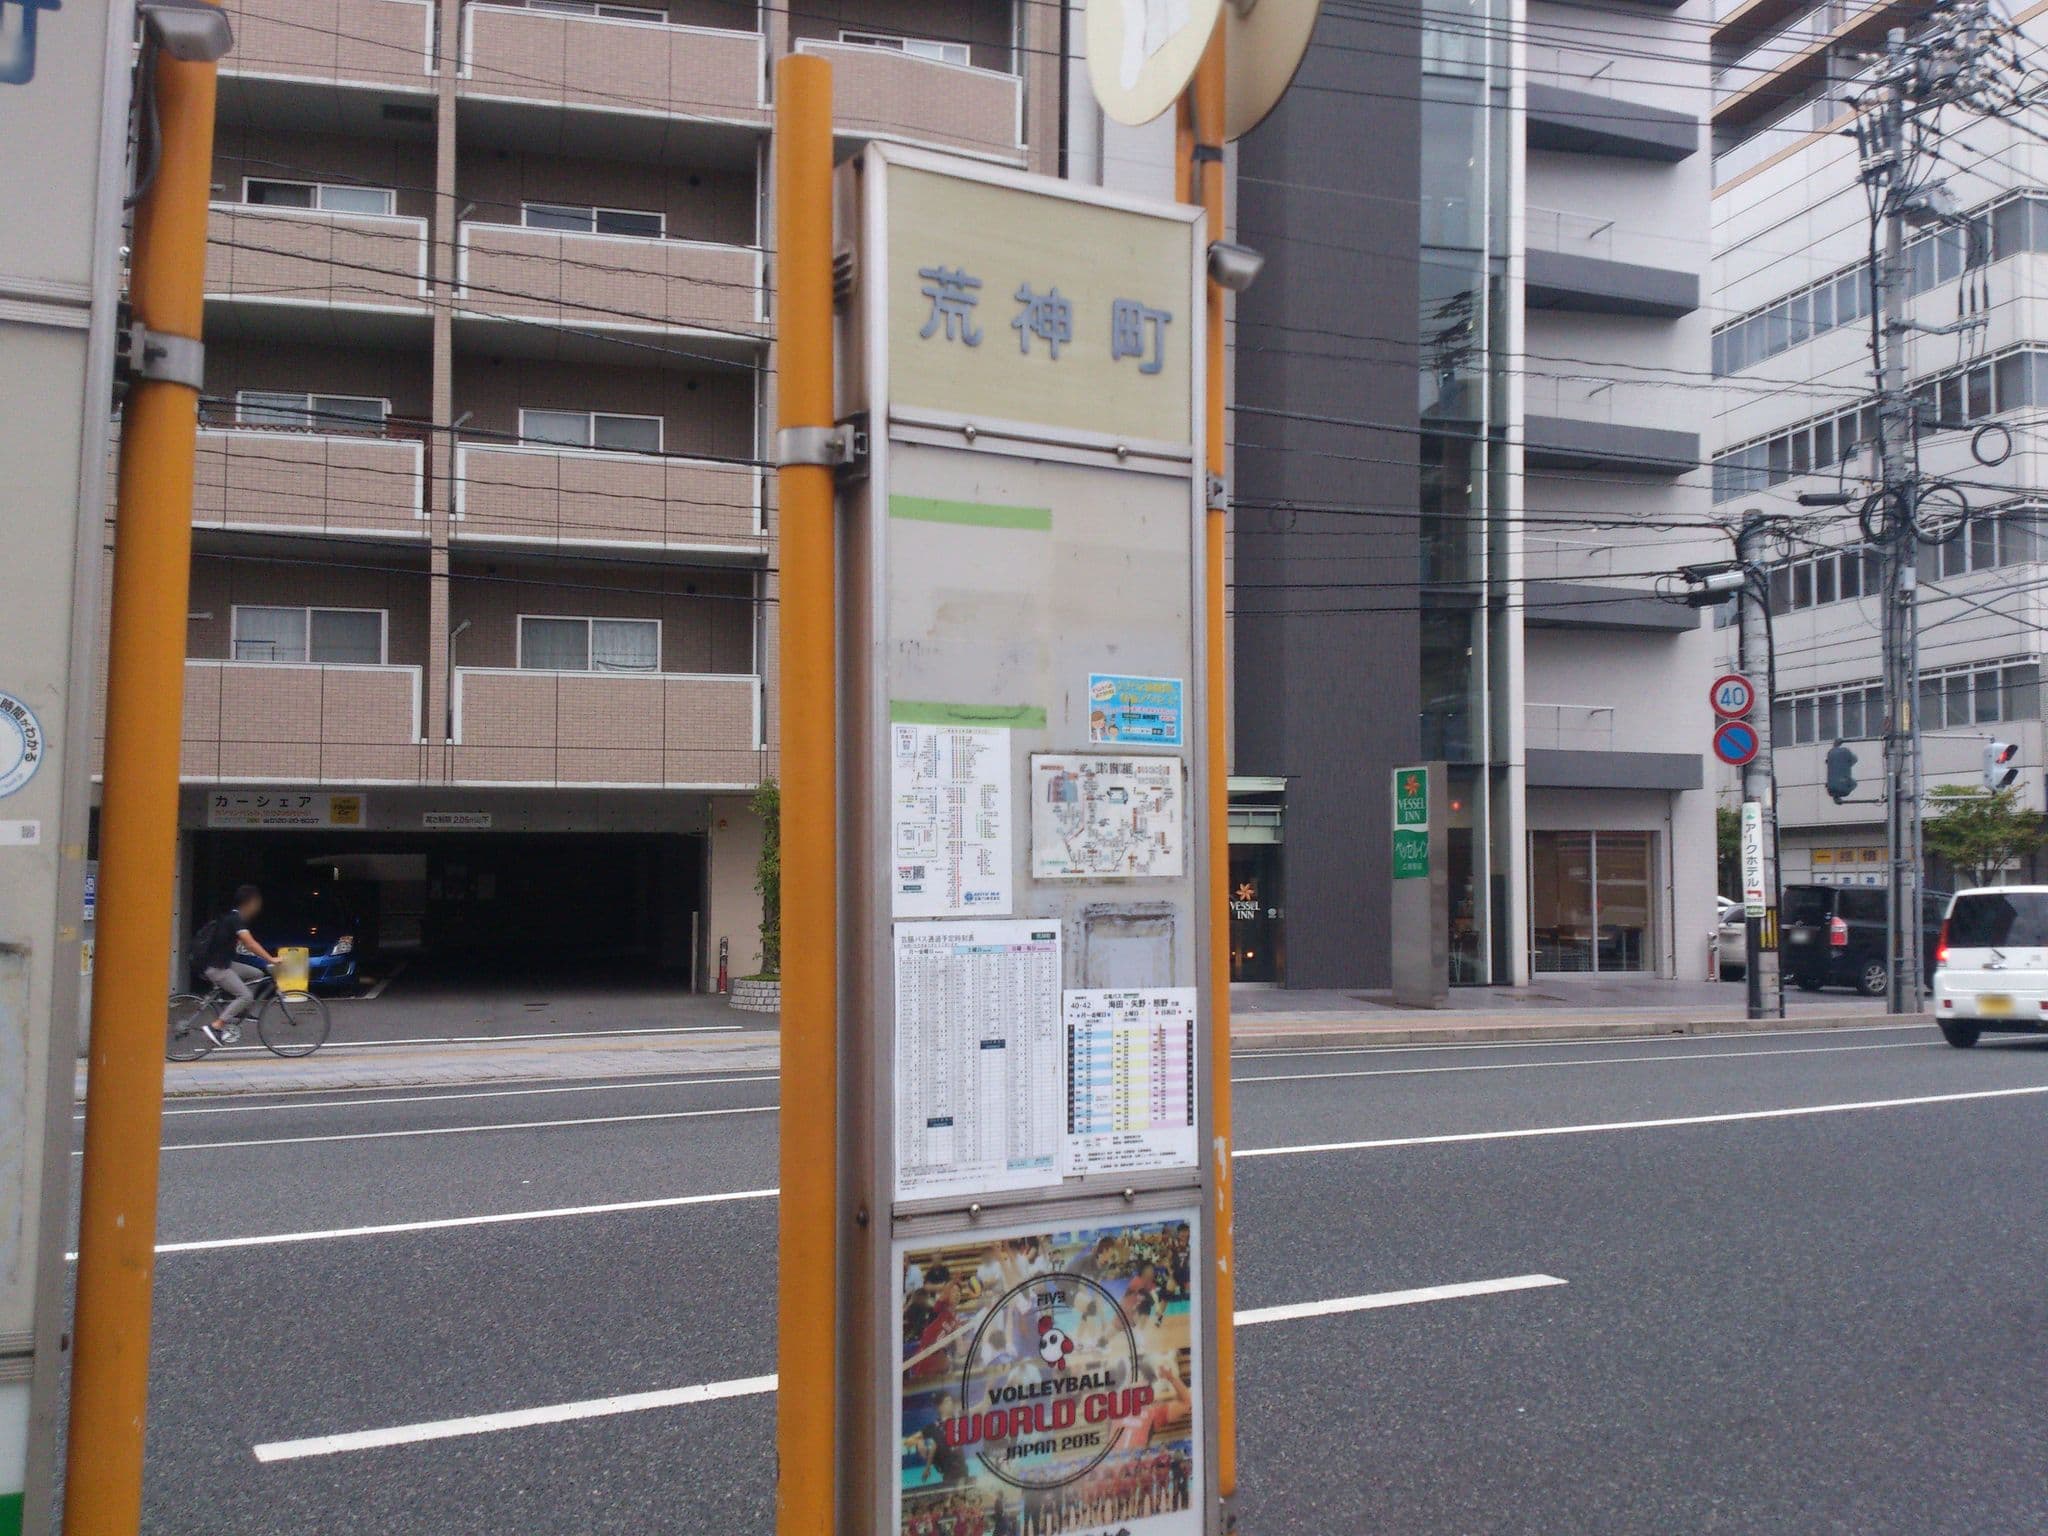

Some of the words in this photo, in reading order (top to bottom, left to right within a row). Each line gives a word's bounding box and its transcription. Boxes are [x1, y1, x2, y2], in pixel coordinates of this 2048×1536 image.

[918, 265, 1172, 376] 荒神町
[1720, 687, 1745, 706] 40
[215, 795, 312, 808] カーシェア
[1398, 798, 1426, 810] VESSEL
[1404, 810, 1421, 822] INN
[1745, 823, 1760, 887] アークホテル
[1230, 901, 1260, 911] VESSEL
[1237, 911, 1255, 920] INN
[1036, 1290, 1065, 1308] FIVB
[989, 1371, 1116, 1405] VOLLEYBALL
[945, 1398, 1076, 1448] WORLD
[1084, 1385, 1154, 1425] CUP
[1004, 1437, 1057, 1461] JAPAN
[1061, 1431, 1101, 1454] 2015
